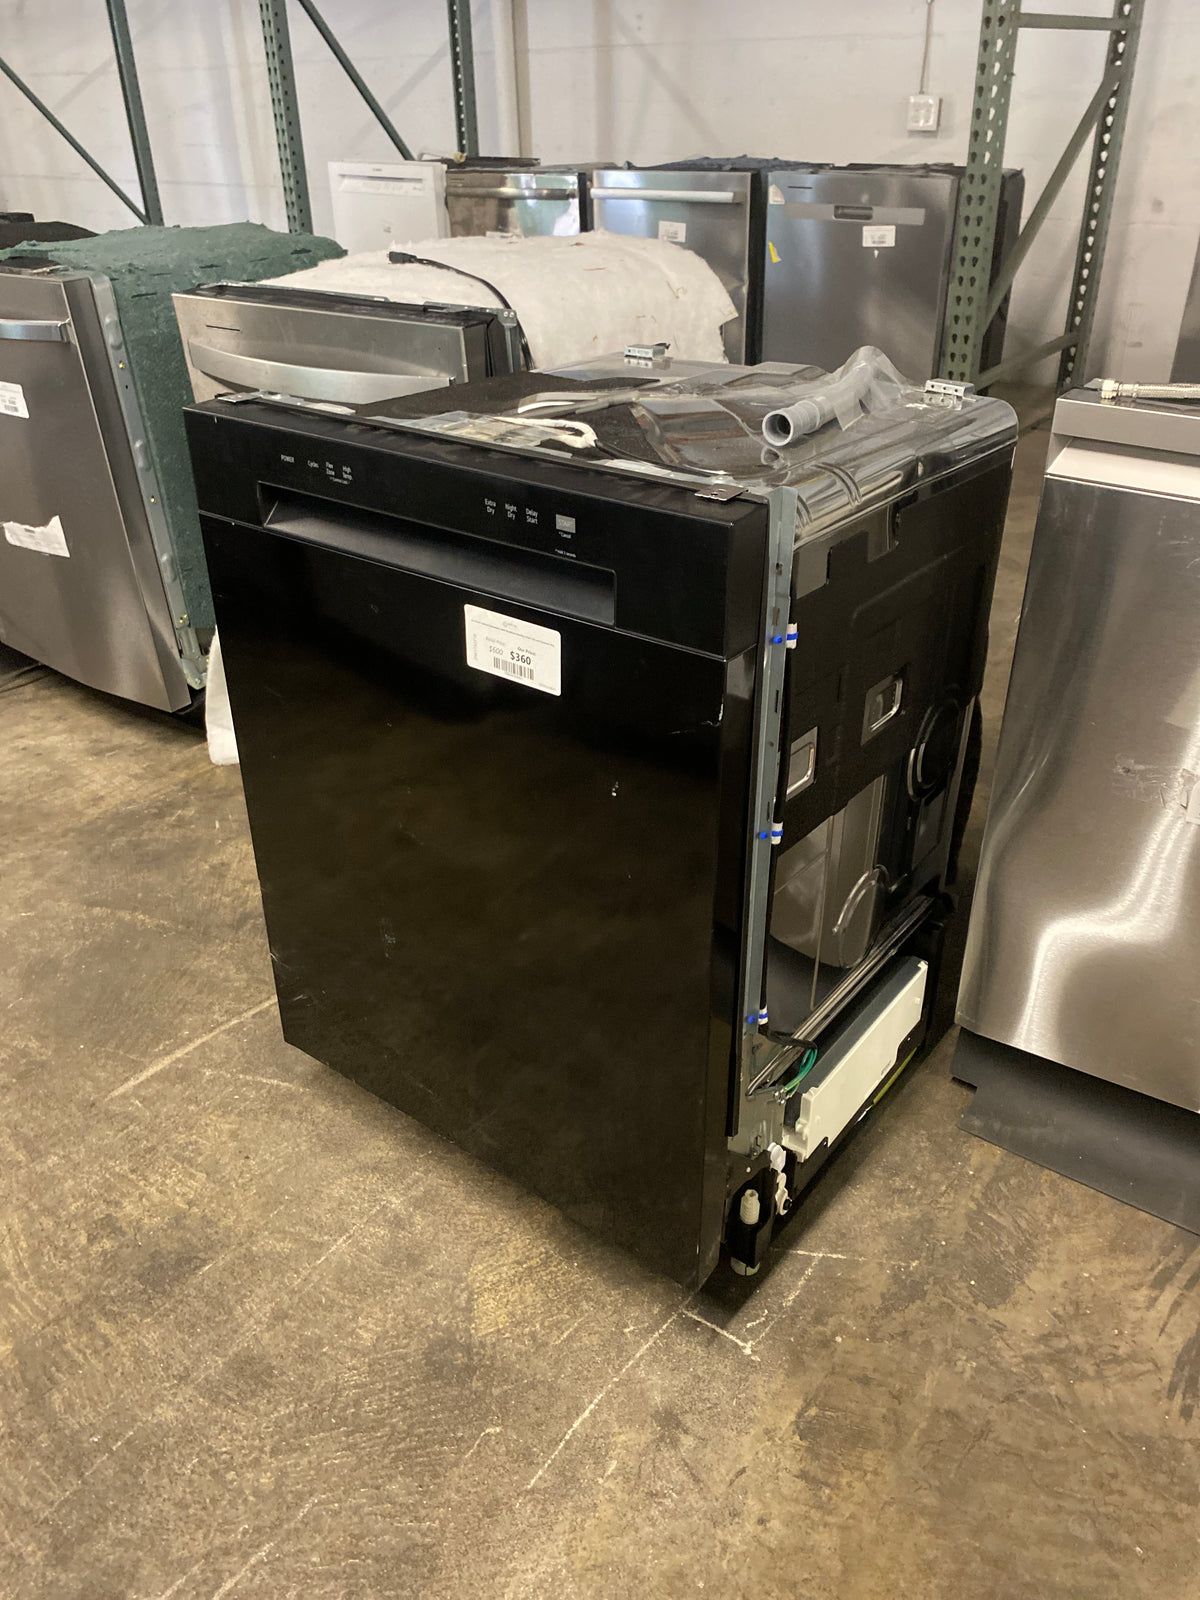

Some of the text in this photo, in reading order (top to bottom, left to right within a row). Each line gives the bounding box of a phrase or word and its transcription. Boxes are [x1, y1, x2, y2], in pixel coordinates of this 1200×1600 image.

[485, 499, 496, 507] Extra
[487, 506, 495, 515] Dry
[526, 508, 538, 518] Delay
[508, 511, 516, 520] Dry
[527, 516, 538, 525] Start
[511, 651, 532, 666] $360
